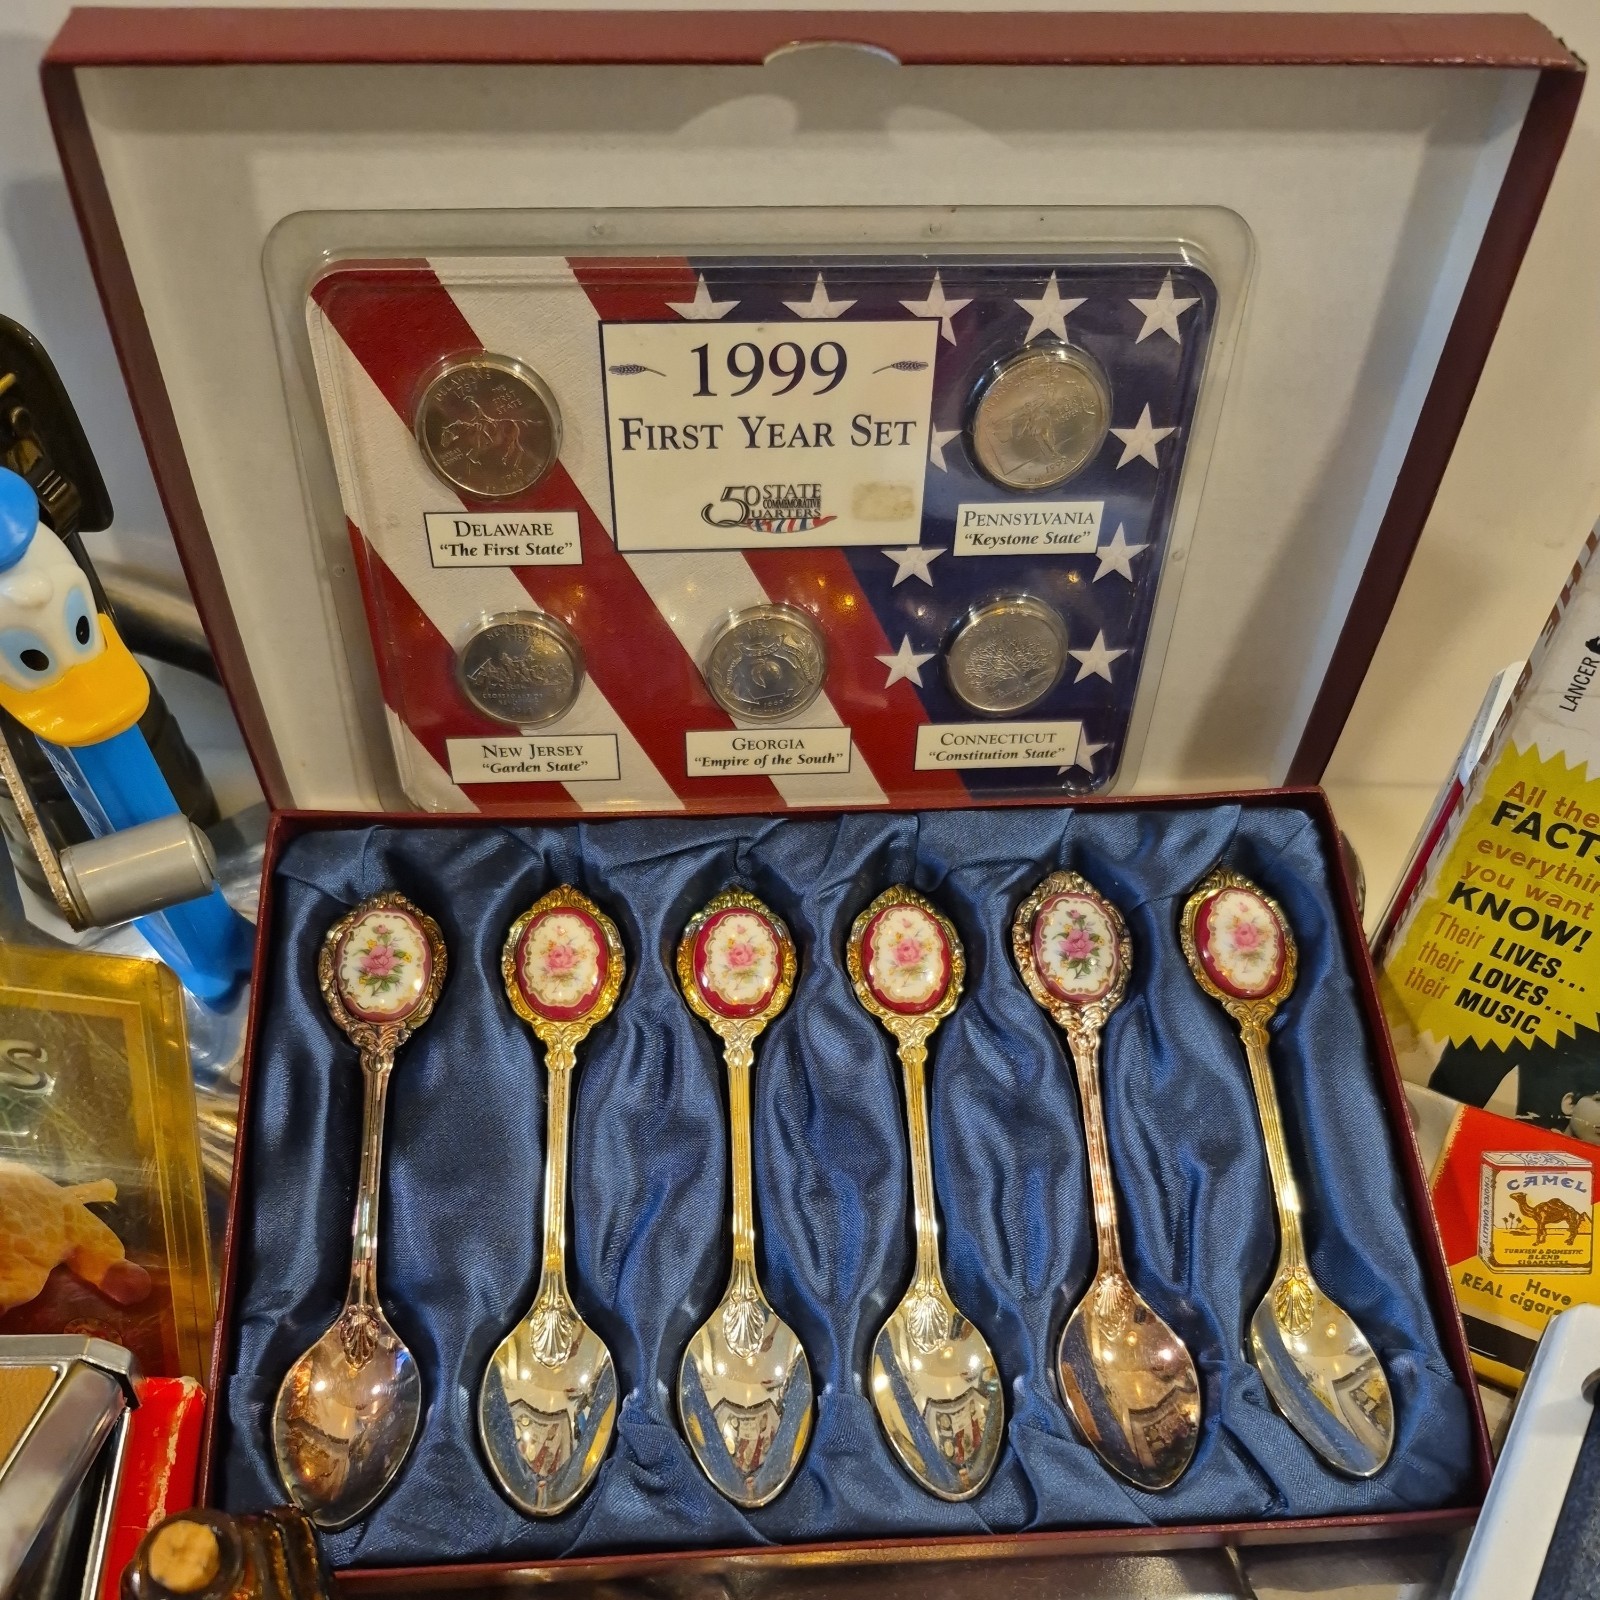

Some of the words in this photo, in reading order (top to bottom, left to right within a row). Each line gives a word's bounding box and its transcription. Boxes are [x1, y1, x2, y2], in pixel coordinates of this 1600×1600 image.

[690, 341, 848, 397] 1999
[618, 416, 723, 450] FIRST
[737, 415, 835, 449] YEAR
[850, 414, 917, 447] SET
[762, 483, 822, 499] STATE
[453, 520, 554, 537] DELAWARE
[963, 510, 1095, 527] PENNSYLVANIA
[483, 543, 520, 556] First
[1559, 656, 1600, 712] LANCER
[482, 744, 523, 758] NEW
[529, 743, 584, 760] JERSEY
[732, 737, 805, 751] GEORGIA
[940, 732, 1058, 746] CONNECTICUT
[754, 754, 769, 768] of
[771, 754, 793, 765] the
[1504, 780, 1548, 808] All
[1554, 796, 1600, 829] the
[1490, 800, 1600, 865] FACT
[1477, 839, 1600, 896] everythin
[1460, 861, 1515, 891] you
[1525, 884, 1595, 920] want
[1433, 911, 1486, 950] Their
[1447, 880, 1593, 954] KNOW!
[1417, 940, 1465, 975] their
[1404, 966, 1451, 1000] their
[1453, 987, 1541, 1035] MUSIC
[1506, 1175, 1587, 1193] CAMEL
[1482, 1208, 1490, 1245] QUALITY
[1460, 1272, 1503, 1298] REAL
[1525, 1279, 1571, 1306] Have
